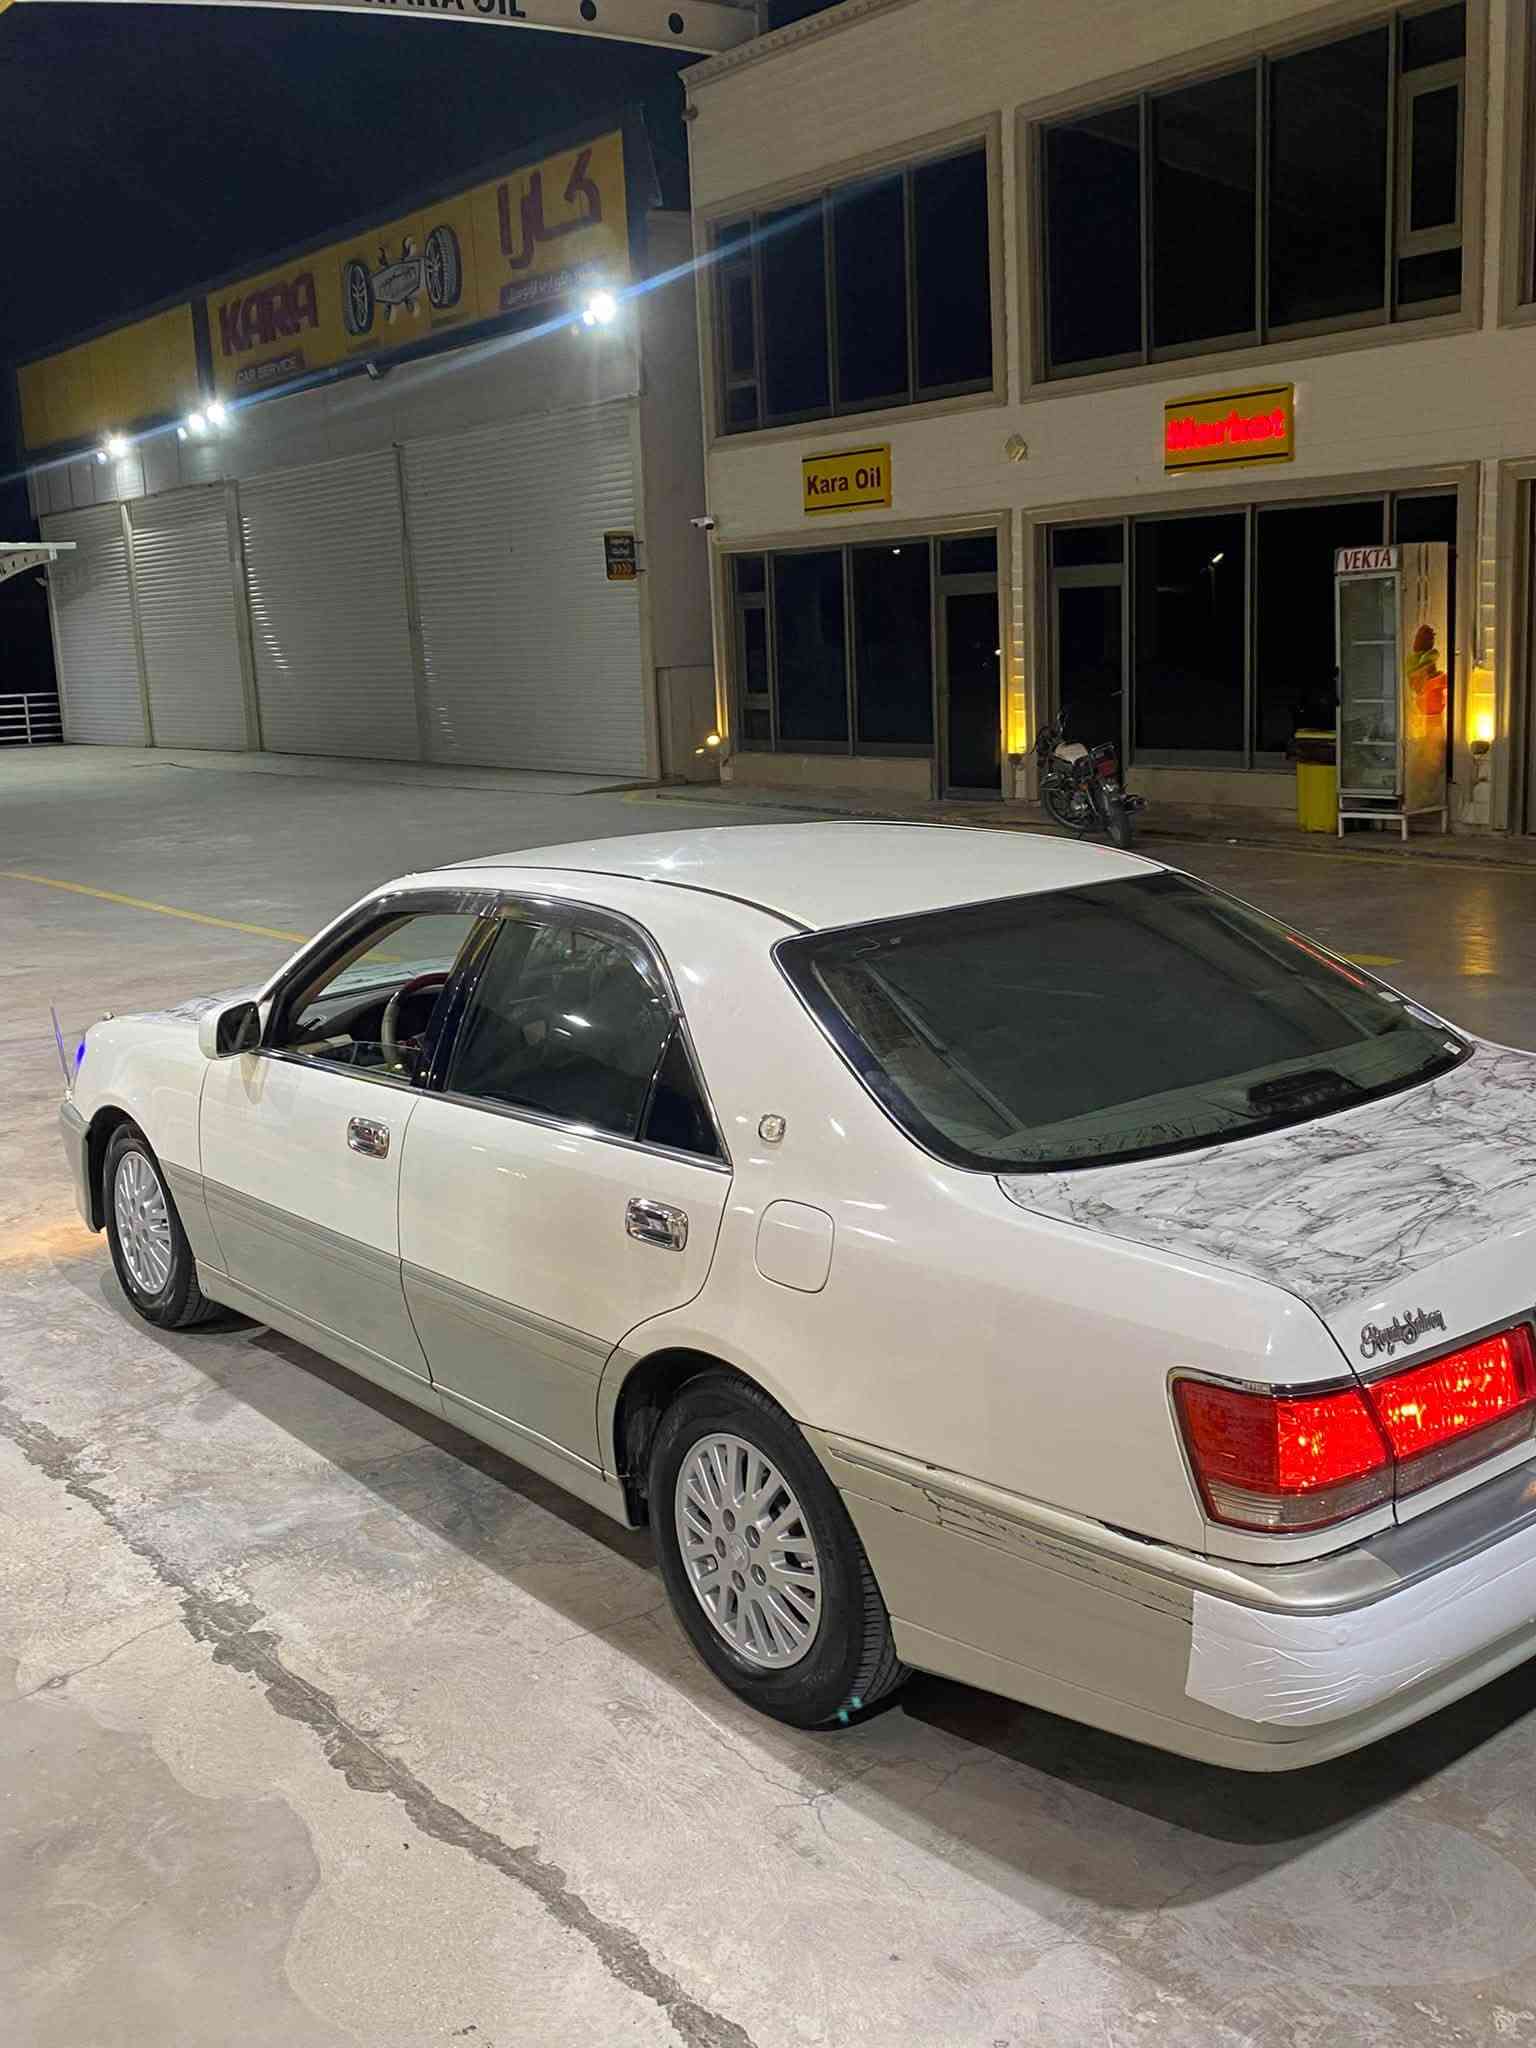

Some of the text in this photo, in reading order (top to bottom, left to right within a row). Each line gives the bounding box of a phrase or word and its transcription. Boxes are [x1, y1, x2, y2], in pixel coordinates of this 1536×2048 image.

[219, 271, 319, 355] KARA
[807, 466, 881, 496] Kara Oil
[1343, 548, 1392, 570] VEKTA
